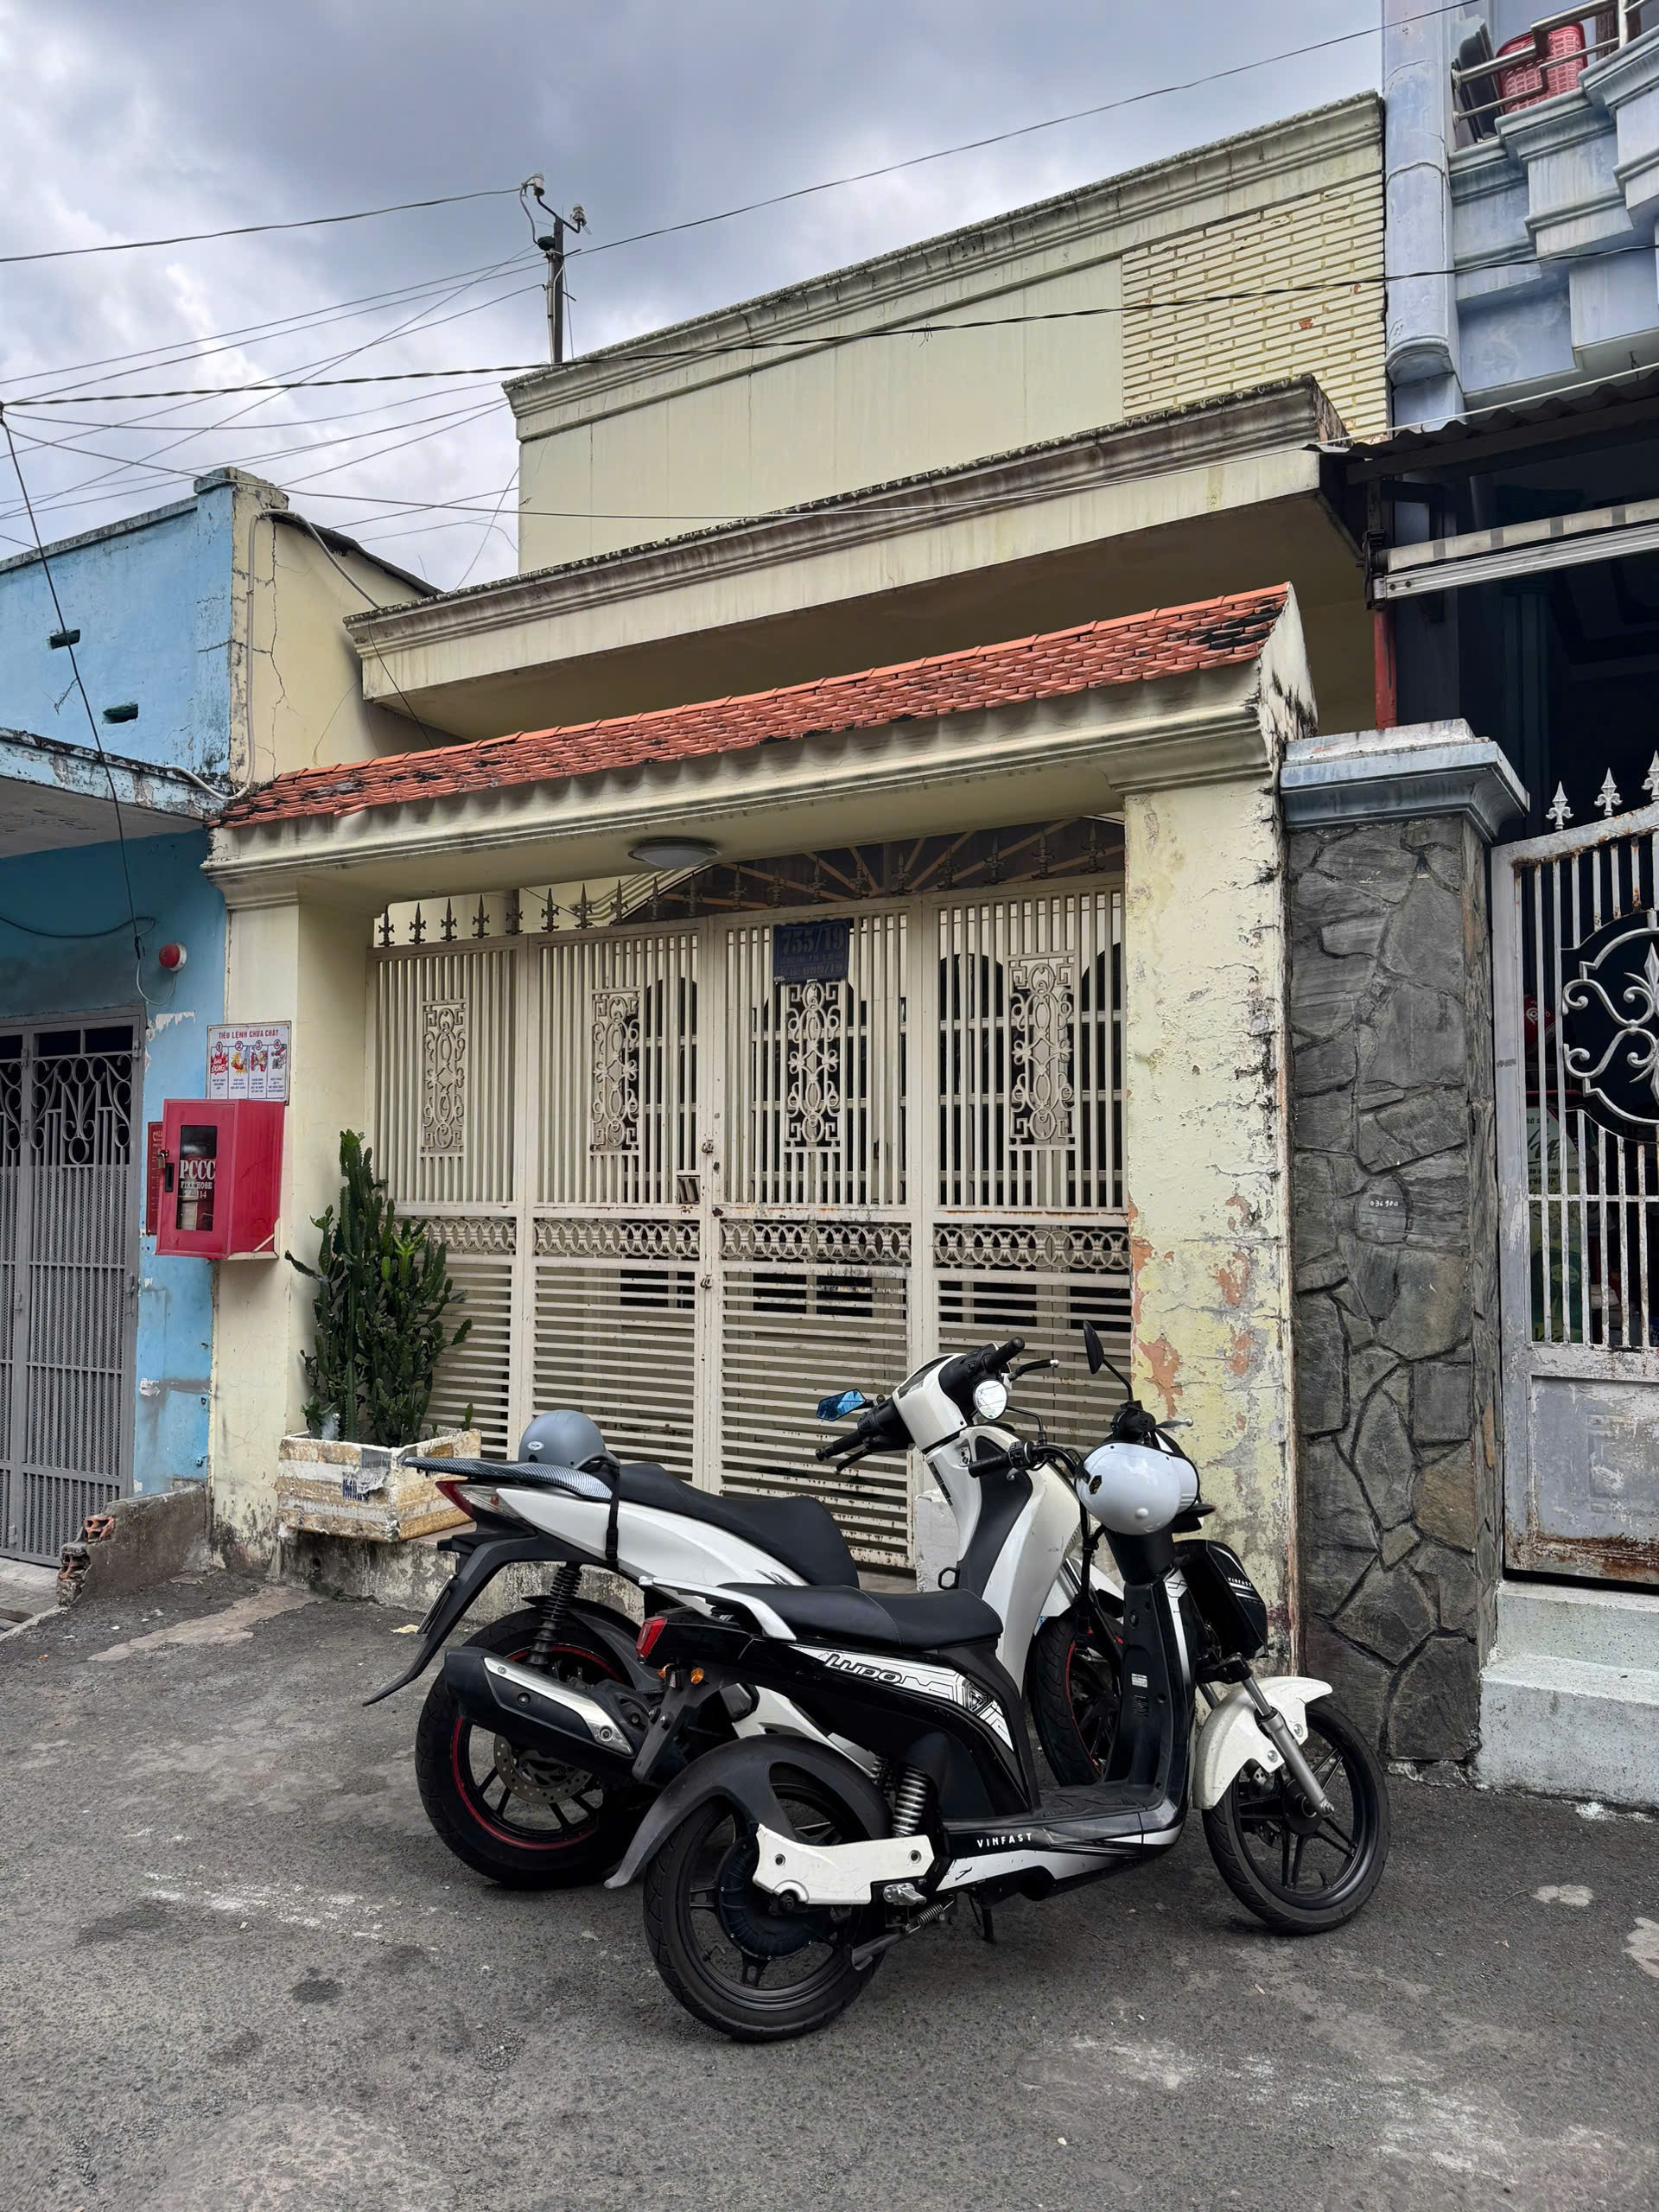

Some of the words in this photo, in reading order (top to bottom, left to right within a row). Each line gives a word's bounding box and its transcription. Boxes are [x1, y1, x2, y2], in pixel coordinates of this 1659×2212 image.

[179, 1160, 216, 1180] PCCC
[181, 1180, 196, 1189] FIRE
[196, 1181, 213, 1190] HOSE
[976, 1832, 1032, 1848] VINFAST
